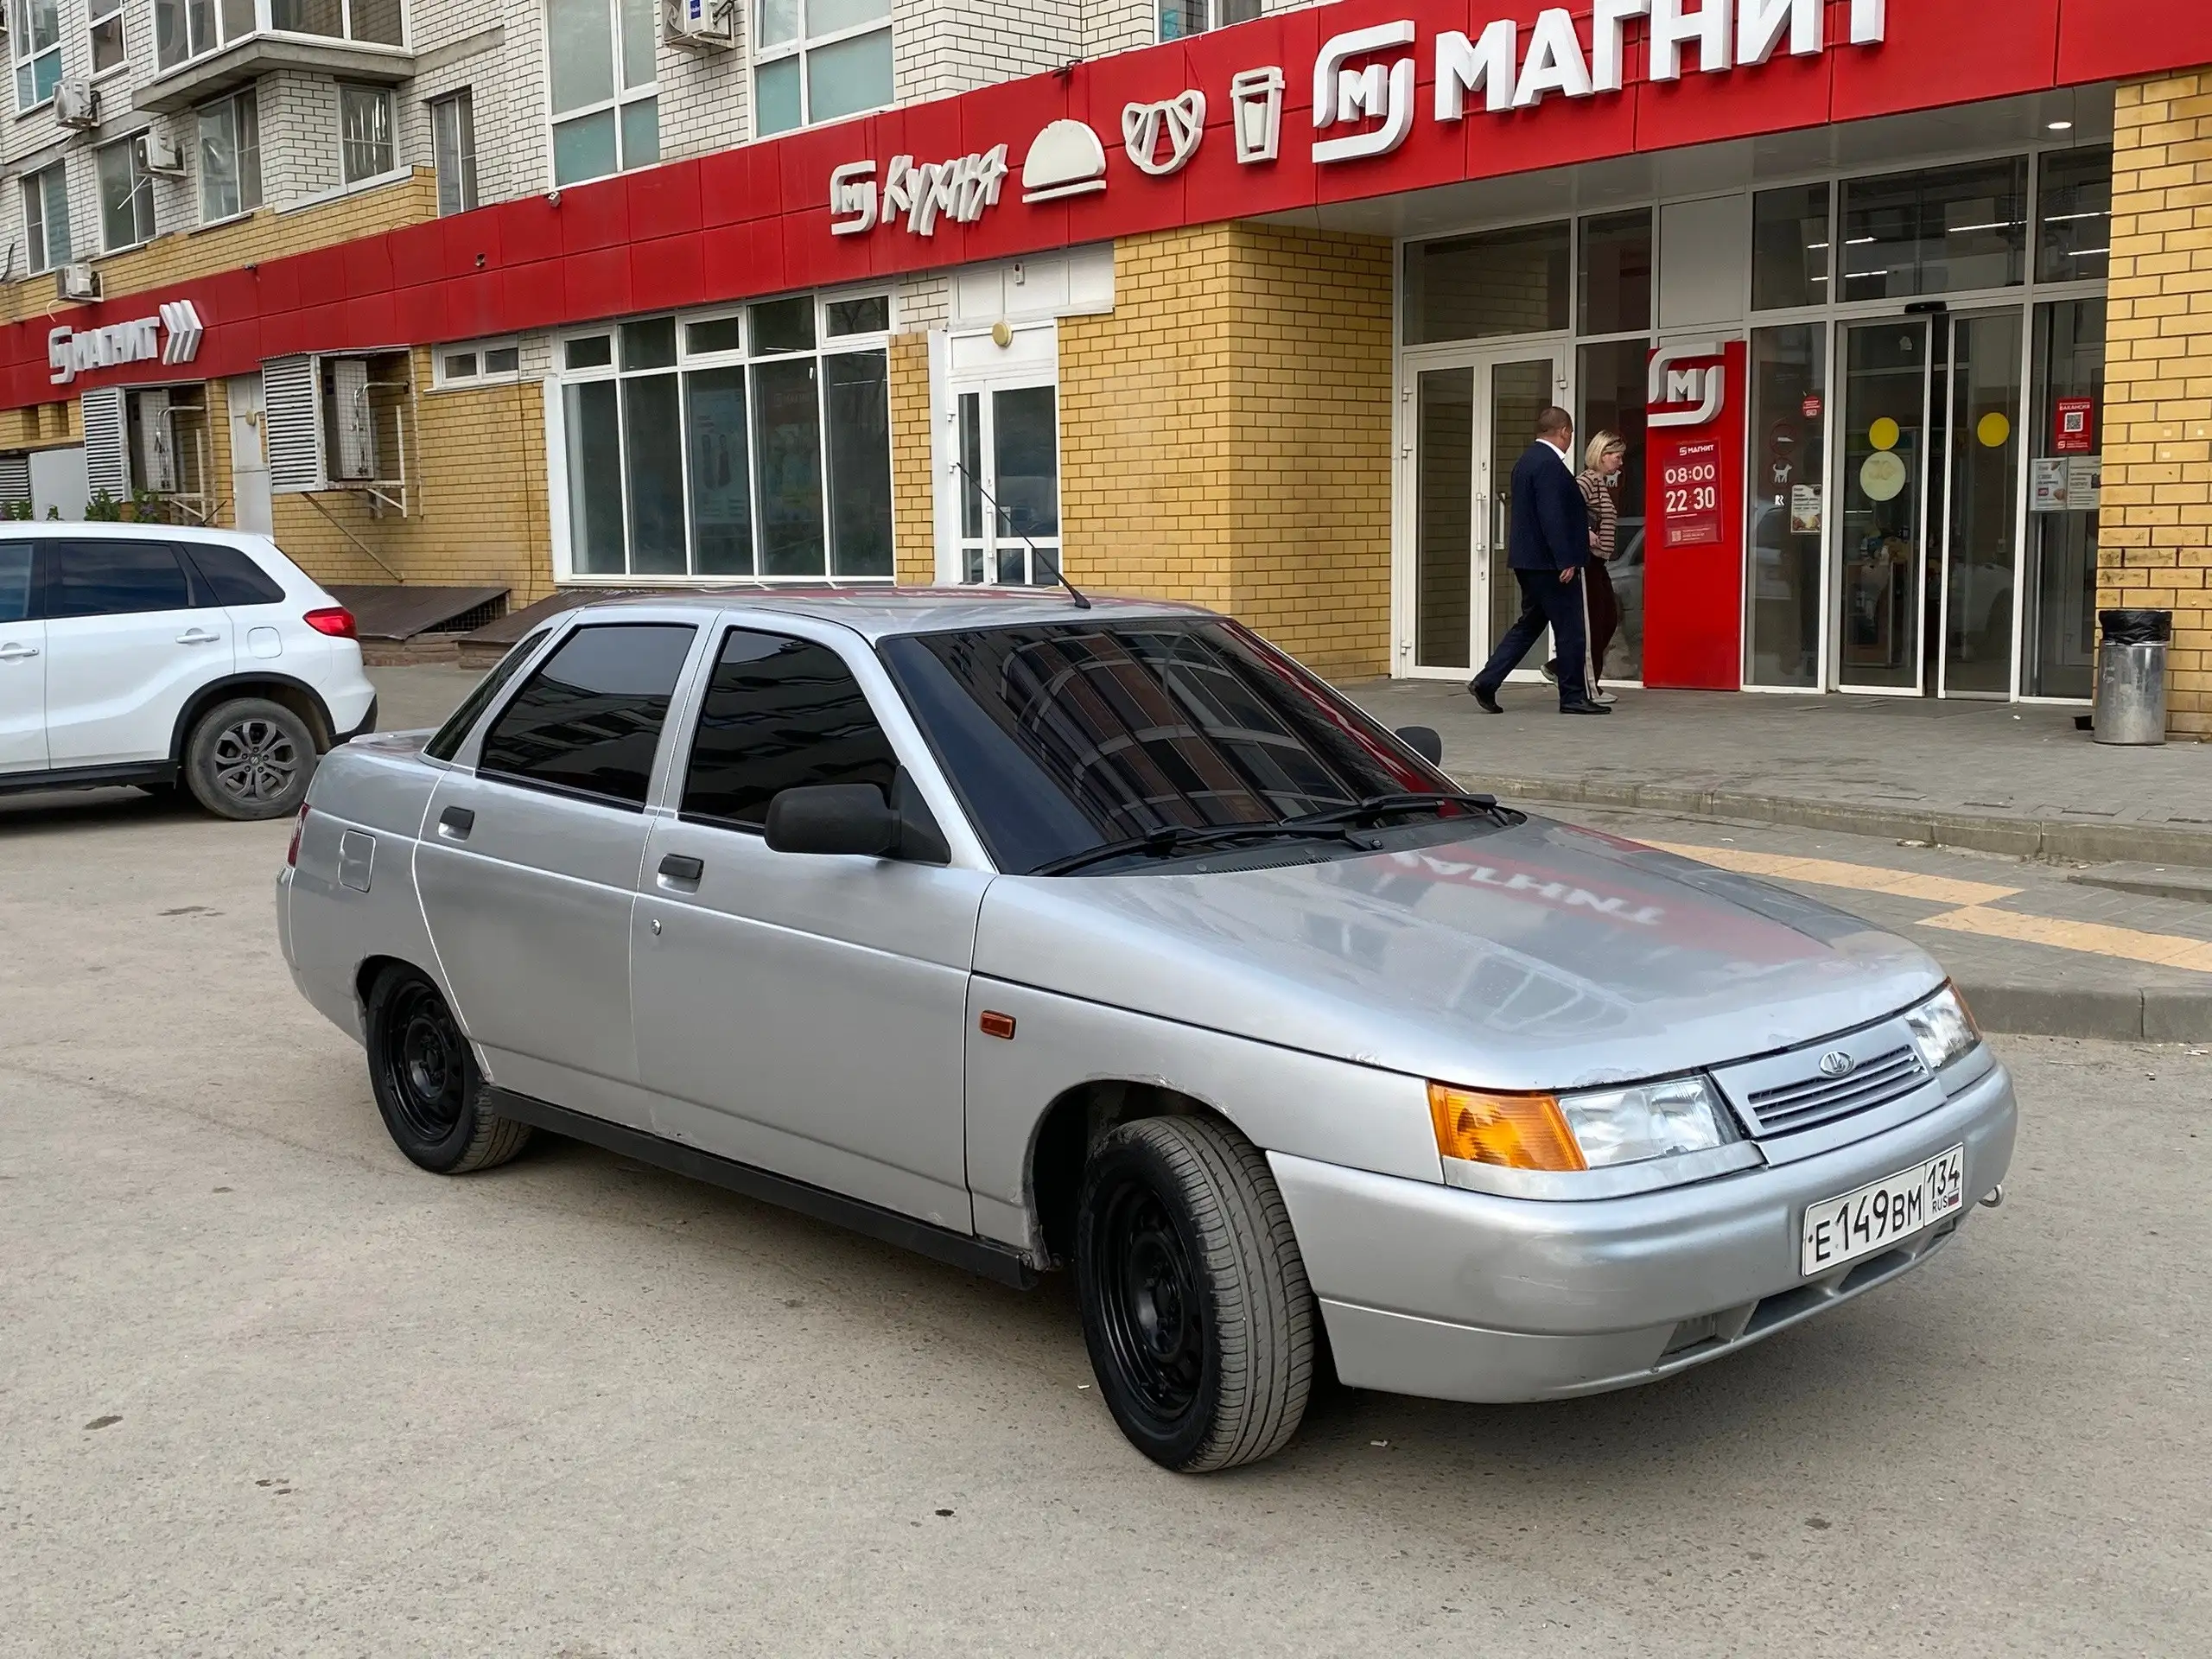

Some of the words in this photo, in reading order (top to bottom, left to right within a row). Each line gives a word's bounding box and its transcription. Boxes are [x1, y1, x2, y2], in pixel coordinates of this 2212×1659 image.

[72, 316, 161, 372] МАГНИТ
[1688, 444, 1714, 454] МАГНИТ
[1665, 464, 1715, 484] 08:00
[1665, 486, 1715, 512] 22:30
[1815, 1184, 1923, 1262] Е149ВМ
[1927, 1154, 1961, 1199] 134
[1932, 1197, 1948, 1214] RUS
